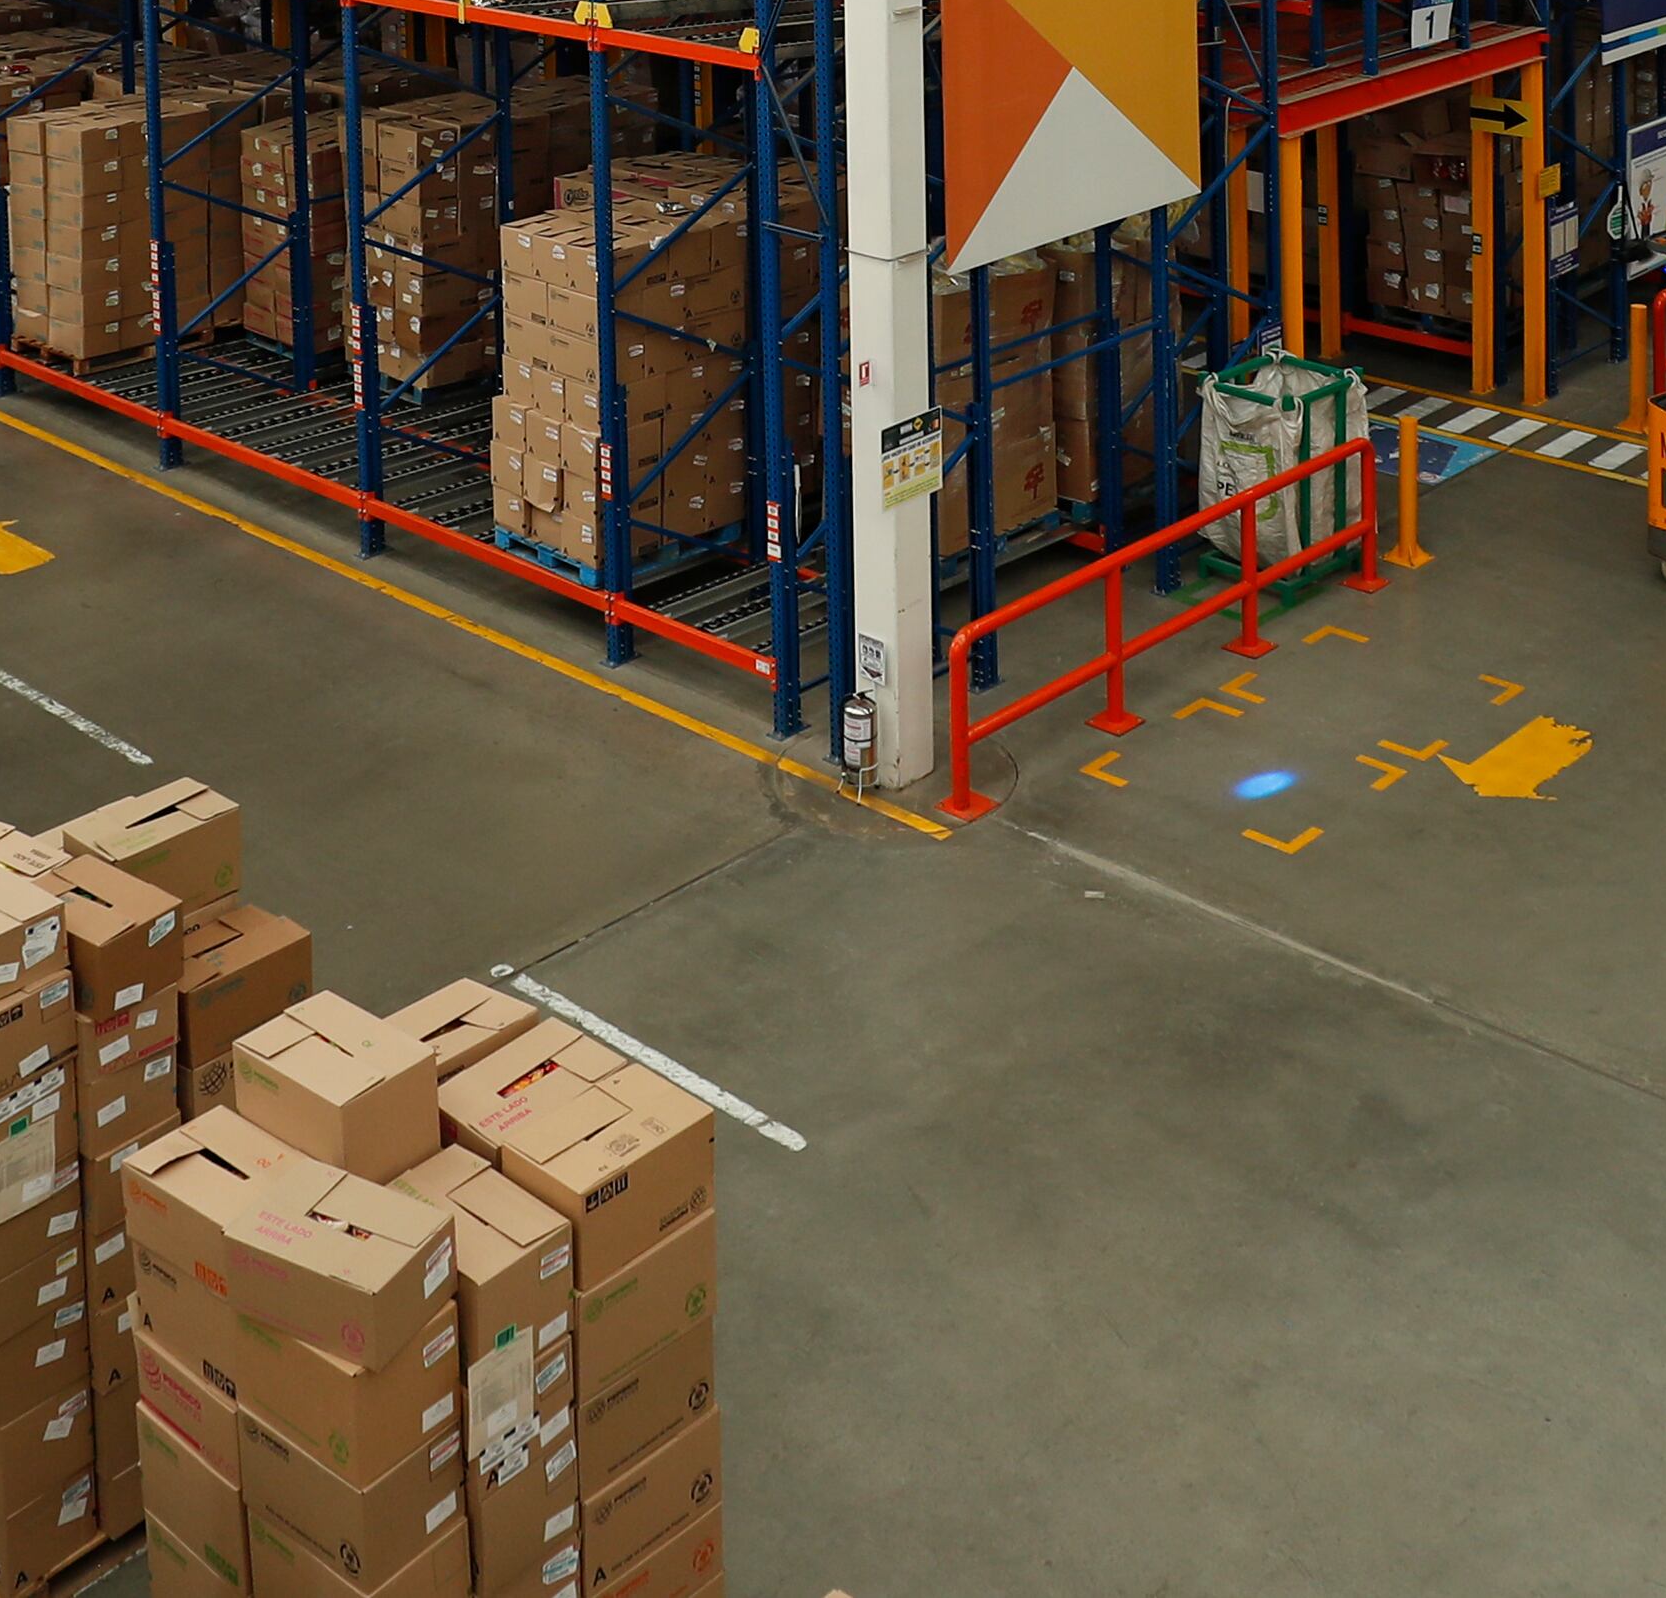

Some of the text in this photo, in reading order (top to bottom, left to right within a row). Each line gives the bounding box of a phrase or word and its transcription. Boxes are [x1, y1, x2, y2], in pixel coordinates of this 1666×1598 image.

[1425, 10, 1435, 40] 1
[478, 1096, 529, 1130] ESTE LADO
[498, 1108, 533, 1133] ARRIBA
[255, 1225, 293, 1246] ARRIBA
[257, 1210, 313, 1240] ESTE LADO
[102, 1287, 115, 1303] A
[143, 1312, 153, 1332] A
[108, 1368, 121, 1385] A
[161, 1371, 202, 1410] PEPSICO
[487, 1469, 499, 1490] A
[14, 1570, 28, 1589] A
[593, 1566, 607, 1587] A
